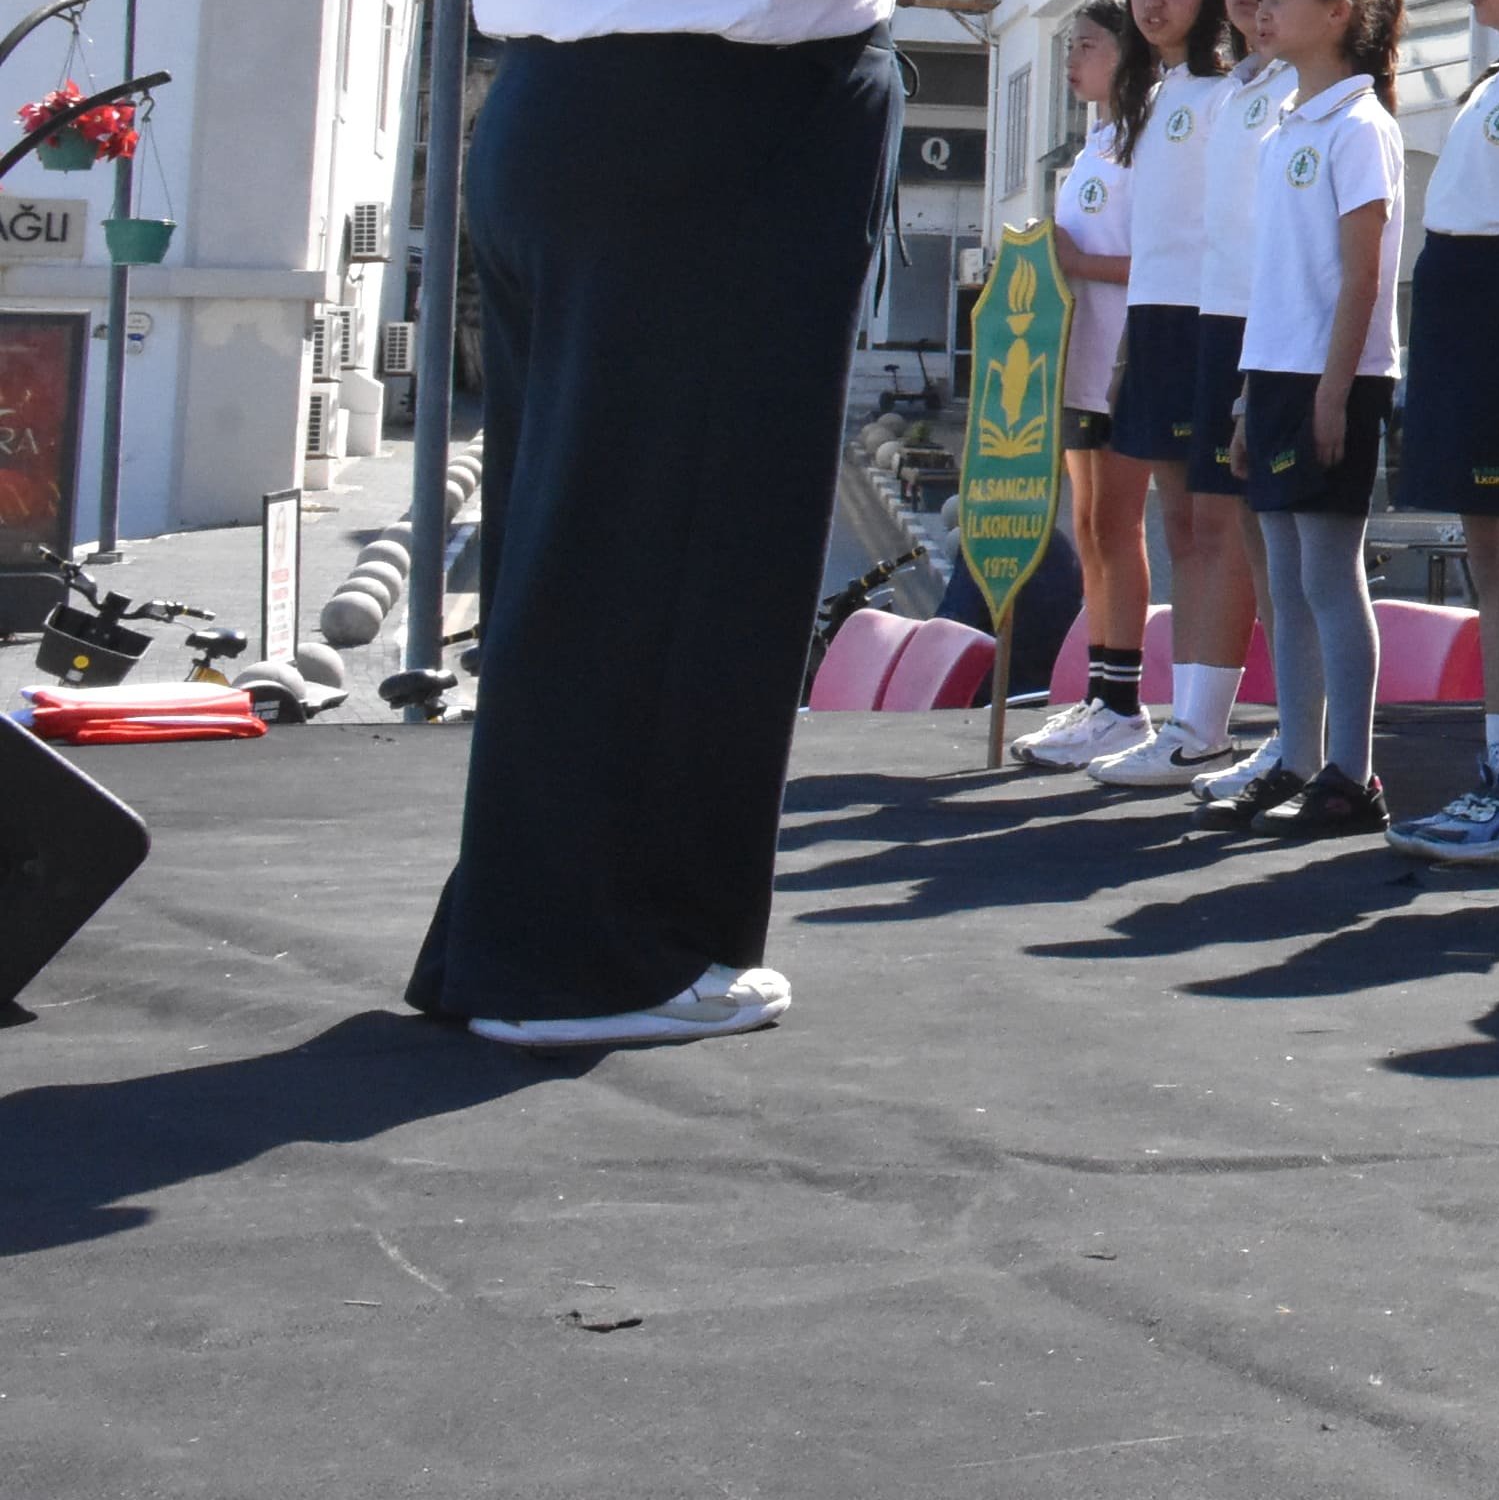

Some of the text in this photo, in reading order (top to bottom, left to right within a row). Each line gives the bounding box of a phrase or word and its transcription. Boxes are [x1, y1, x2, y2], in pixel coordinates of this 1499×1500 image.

[921, 136, 950, 171] Q
[968, 476, 1048, 501] ALSANCAK
[967, 509, 1044, 539] İLKOKULU
[984, 557, 1019, 579] 1975
